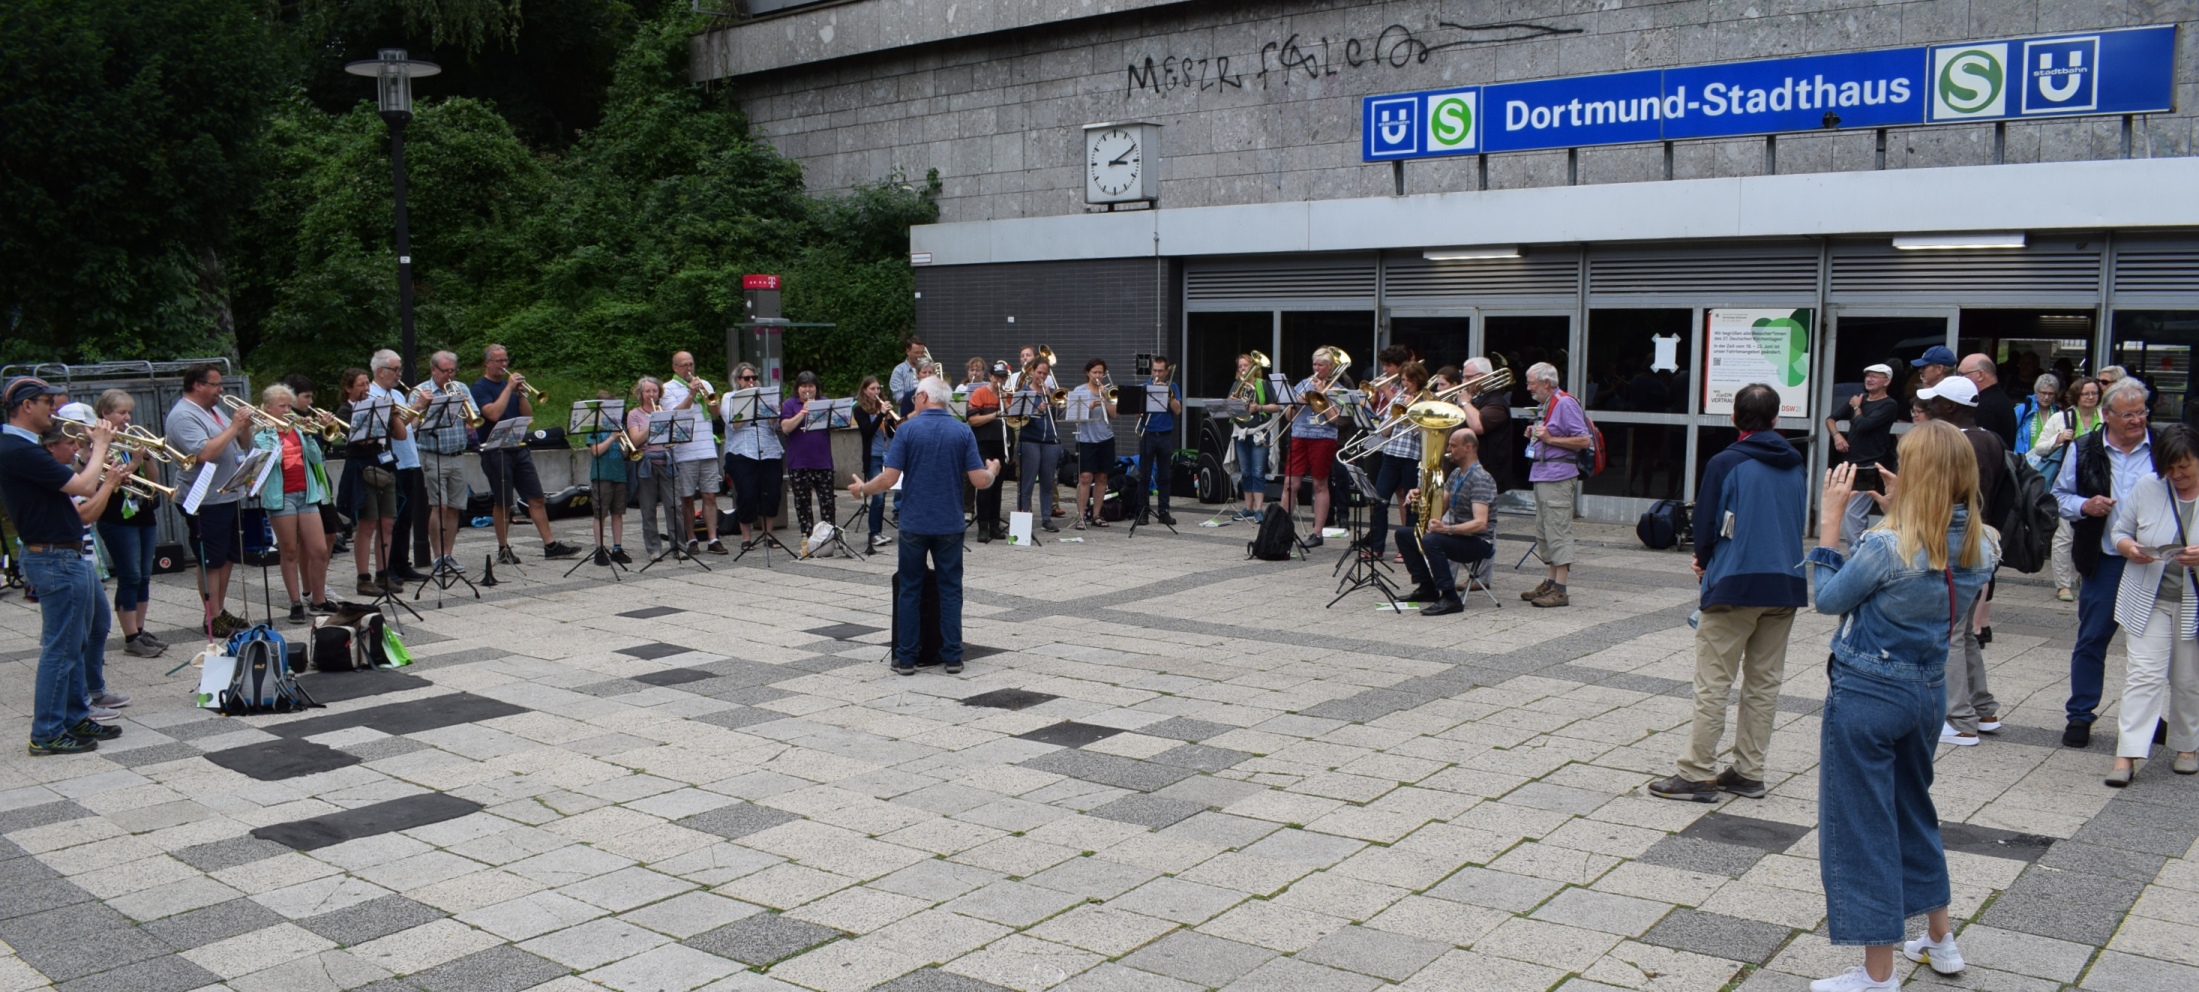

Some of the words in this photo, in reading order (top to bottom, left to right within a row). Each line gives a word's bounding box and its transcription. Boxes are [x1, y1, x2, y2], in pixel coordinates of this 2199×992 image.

[1947, 54, 1992, 109] S
[2033, 66, 2088, 77] stadtbahn
[2039, 50, 2083, 102] U
[1438, 102, 1465, 141] S
[1505, 74, 1911, 132] Dortmund-Stadthaus
[1381, 109, 1407, 145] U
